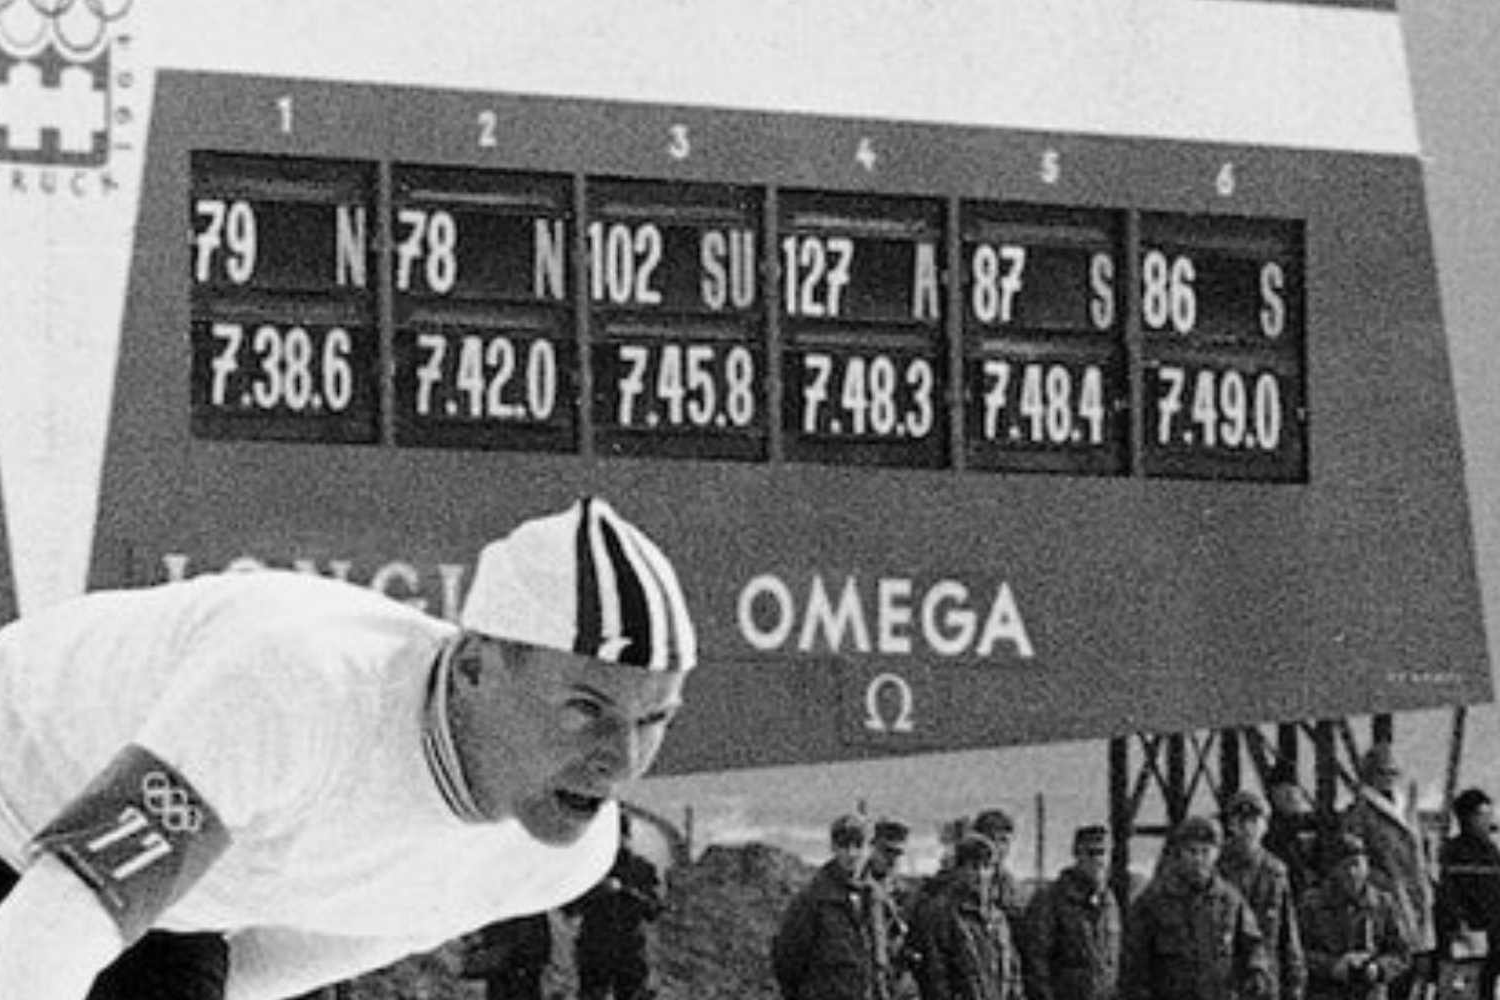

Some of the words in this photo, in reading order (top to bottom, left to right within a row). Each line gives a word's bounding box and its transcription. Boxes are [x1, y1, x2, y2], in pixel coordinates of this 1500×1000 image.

[276, 95, 294, 134] 1
[477, 109, 498, 148] 2
[668, 123, 691, 160] 3
[855, 137, 877, 172] 4
[1040, 148, 1061, 185] 5
[1214, 161, 1236, 197] 6
[196, 199, 257, 284] 79
[335, 204, 367, 288] N
[396, 208, 457, 294] 78
[534, 217, 566, 301] N
[587, 220, 663, 305] 102
[700, 229, 756, 311] SU
[782, 235, 854, 318] 127
[911, 241, 940, 321] A
[972, 243, 1026, 324] 87
[1089, 251, 1115, 331] S
[1142, 250, 1197, 335] 86
[1259, 260, 1286, 339] S
[211, 322, 353, 411] 7.38.6
[416, 333, 557, 421] 7.42.0
[618, 344, 755, 428] 7.45.8
[803, 353, 934, 438] 7.48.3
[983, 360, 1105, 445] 7.48.4
[1157, 366, 1282, 451] 7.49.0
[736, 573, 1035, 658] OMEGA
